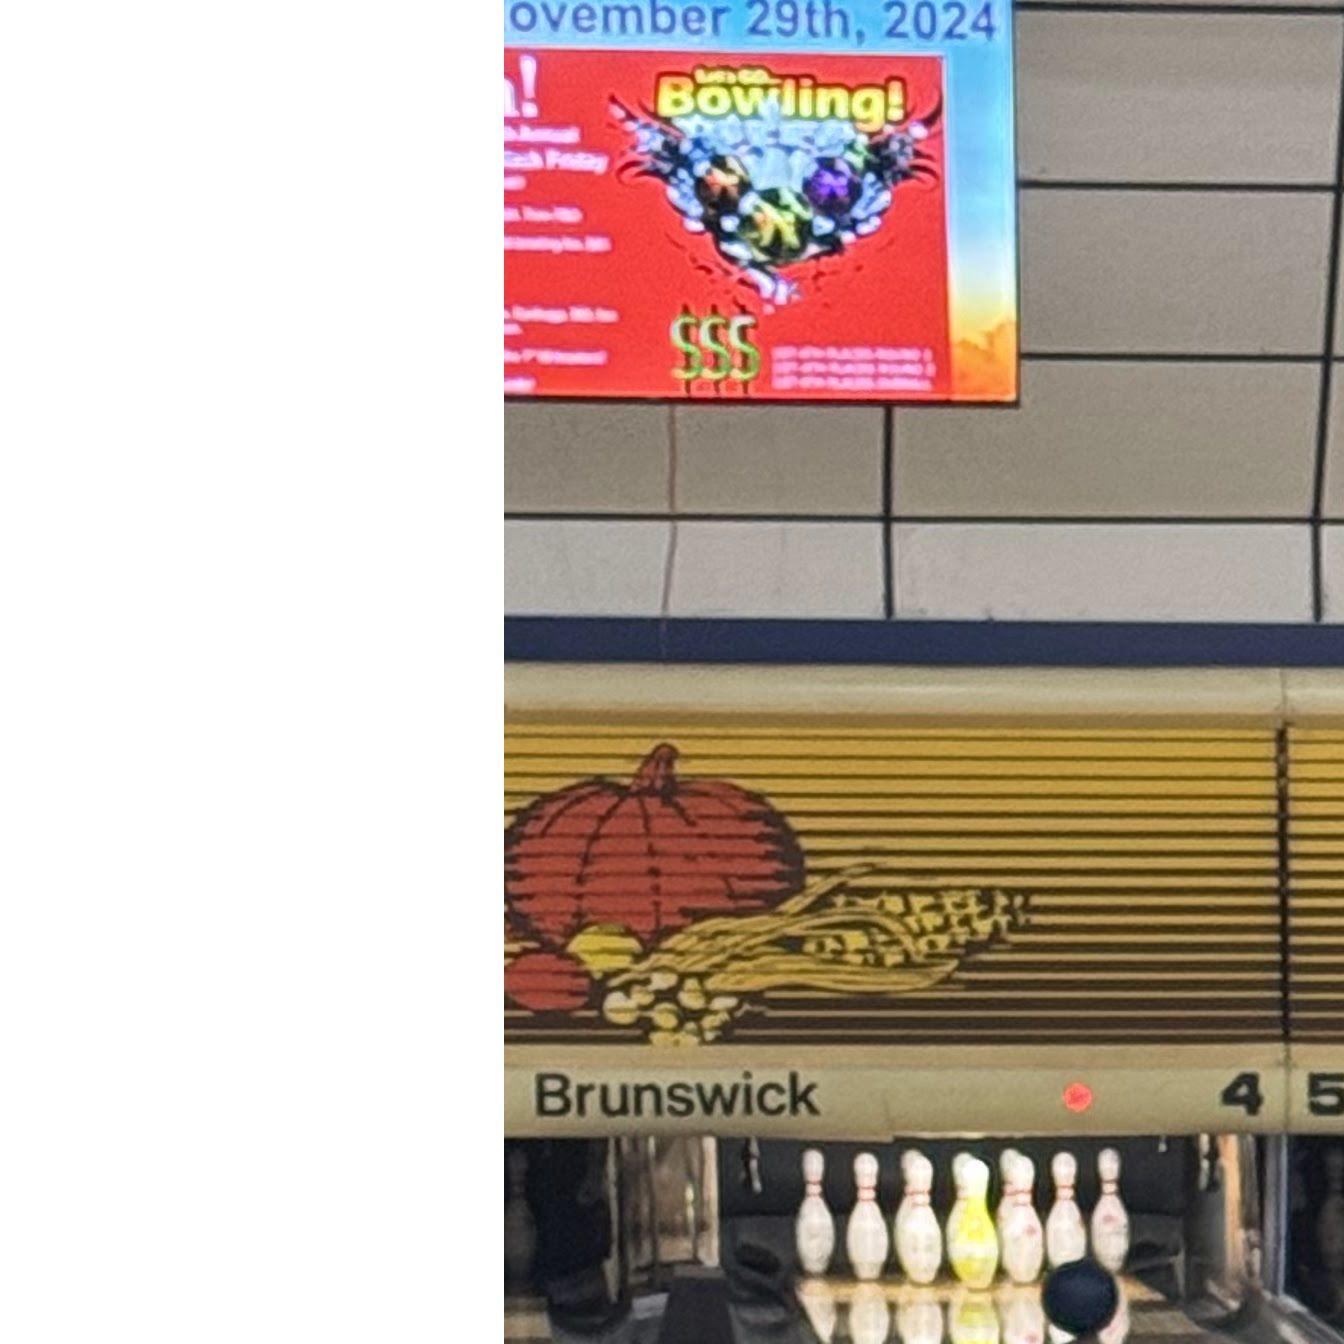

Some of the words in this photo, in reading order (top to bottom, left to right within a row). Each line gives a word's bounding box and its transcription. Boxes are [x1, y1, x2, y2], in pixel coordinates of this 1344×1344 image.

[883, 1, 996, 40] 2024
[656, 74, 905, 132] Bowling!
[536, 1072, 820, 1118] Brunswick
[1221, 1073, 1263, 1116] 4
